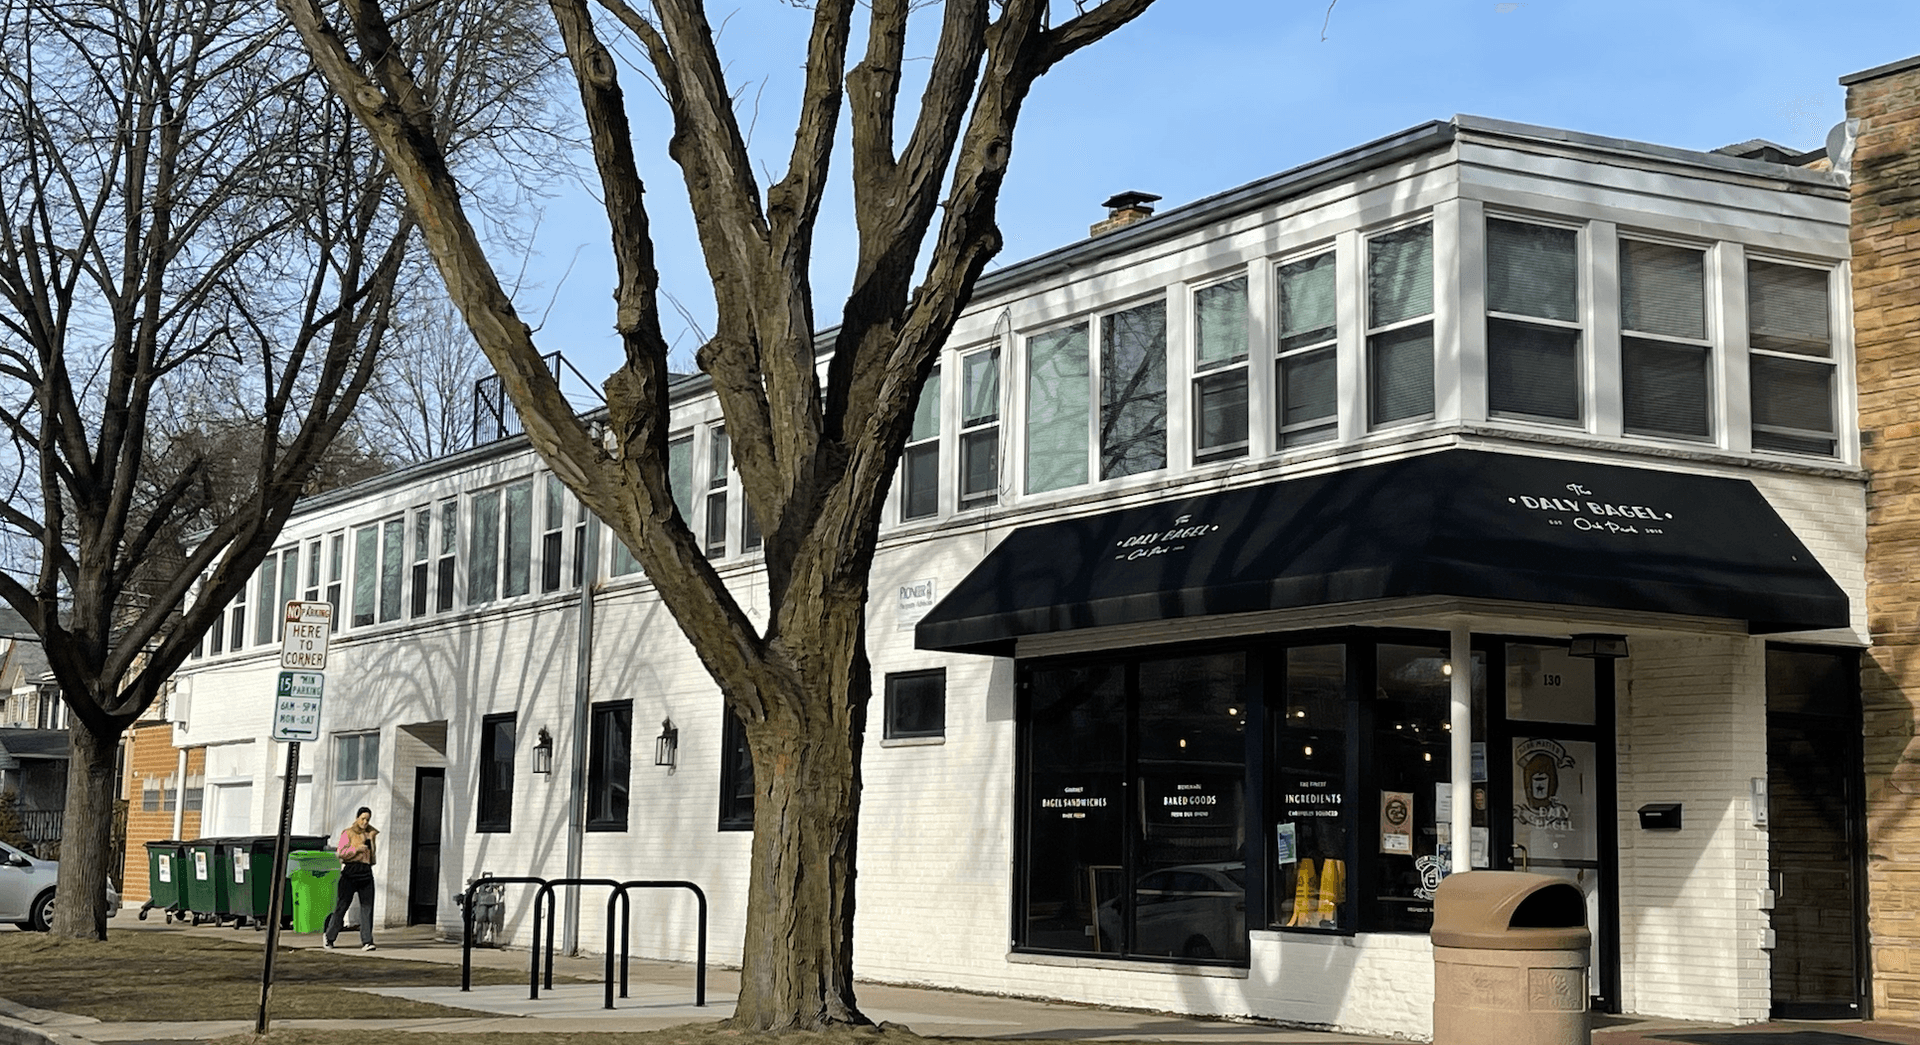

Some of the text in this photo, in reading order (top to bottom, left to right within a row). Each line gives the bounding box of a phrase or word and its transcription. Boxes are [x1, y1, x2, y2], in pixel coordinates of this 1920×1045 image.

[1520, 495, 1664, 521] DALY BAGEL
[1573, 517, 1604, 531] Oak
[1604, 520, 1639, 534] Park
[1122, 524, 1210, 548] DALY BAGEL
[287, 605, 330, 618] NO PARKING
[293, 625, 322, 638] HERE
[299, 639, 313, 651] TO
[285, 652, 323, 666] CORNER
[280, 677, 292, 691] 15
[1543, 674, 1561, 686] 130
[292, 686, 322, 696] PARKING
[1042, 797, 1107, 807] BAGEL SANDWICHES
[1163, 795, 1216, 805] BAKED GOODS
[1285, 793, 1341, 804] INGREDIENTS
